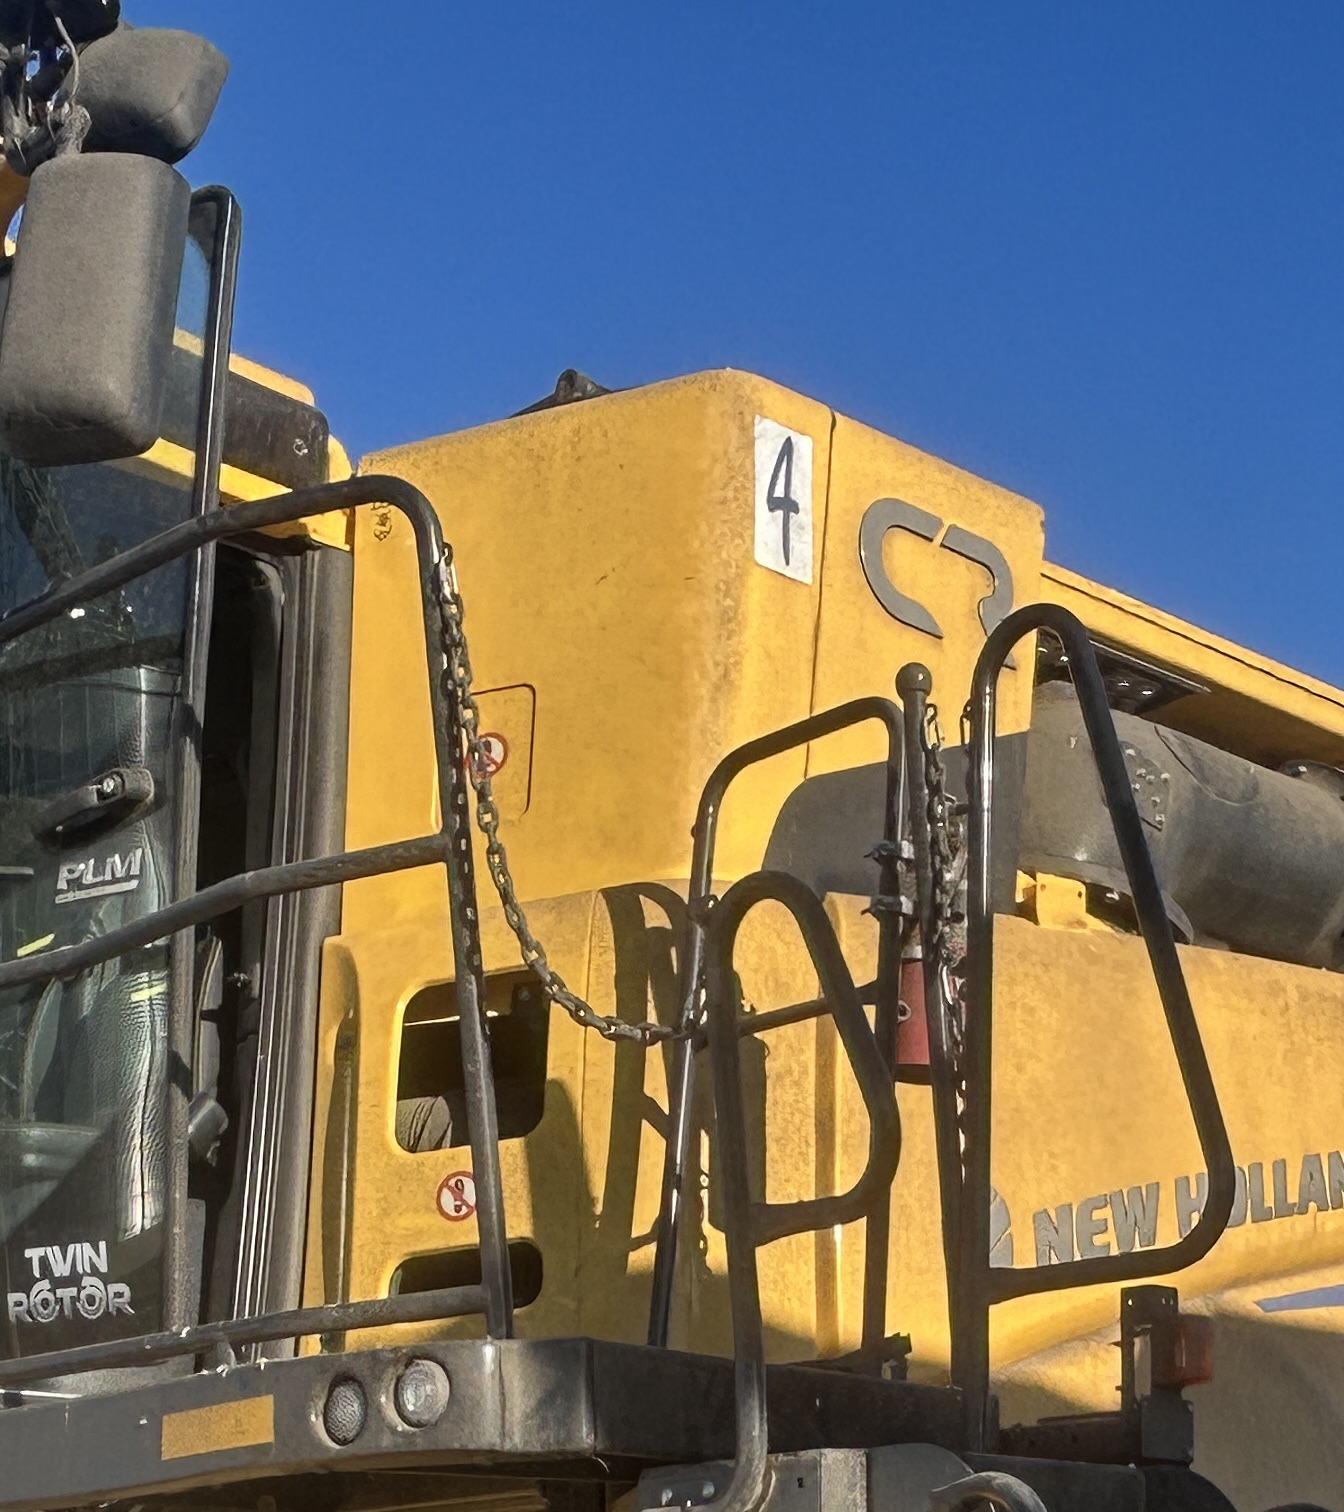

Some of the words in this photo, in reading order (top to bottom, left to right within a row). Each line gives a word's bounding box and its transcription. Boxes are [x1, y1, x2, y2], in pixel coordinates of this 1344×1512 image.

[766, 435, 800, 567] 4
[56, 847, 143, 890] PLM
[1032, 1181, 1160, 1267] NEW
[24, 1240, 108, 1278] TWIN
[7, 1276, 136, 1323] ROTOR
